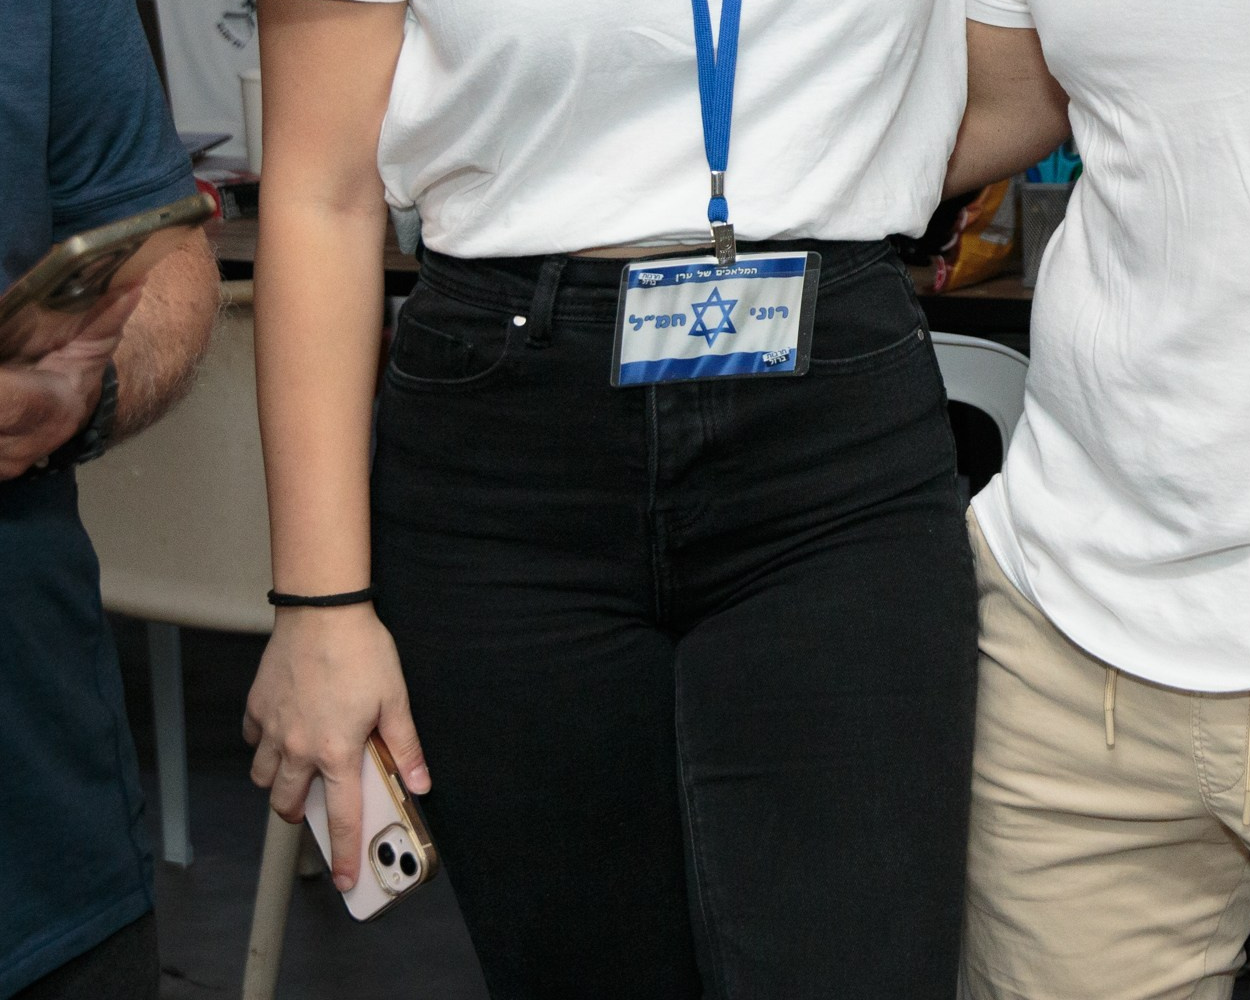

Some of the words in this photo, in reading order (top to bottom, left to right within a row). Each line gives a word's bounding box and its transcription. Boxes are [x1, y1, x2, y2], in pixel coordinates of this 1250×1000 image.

[696, 269, 712, 278] של
[716, 267, 757, 276] המלאכים
[675, 273, 693, 282] ערן
[750, 306, 789, 320] רוני
[767, 349, 788, 359] חרבות
[769, 356, 787, 365] ברזל
